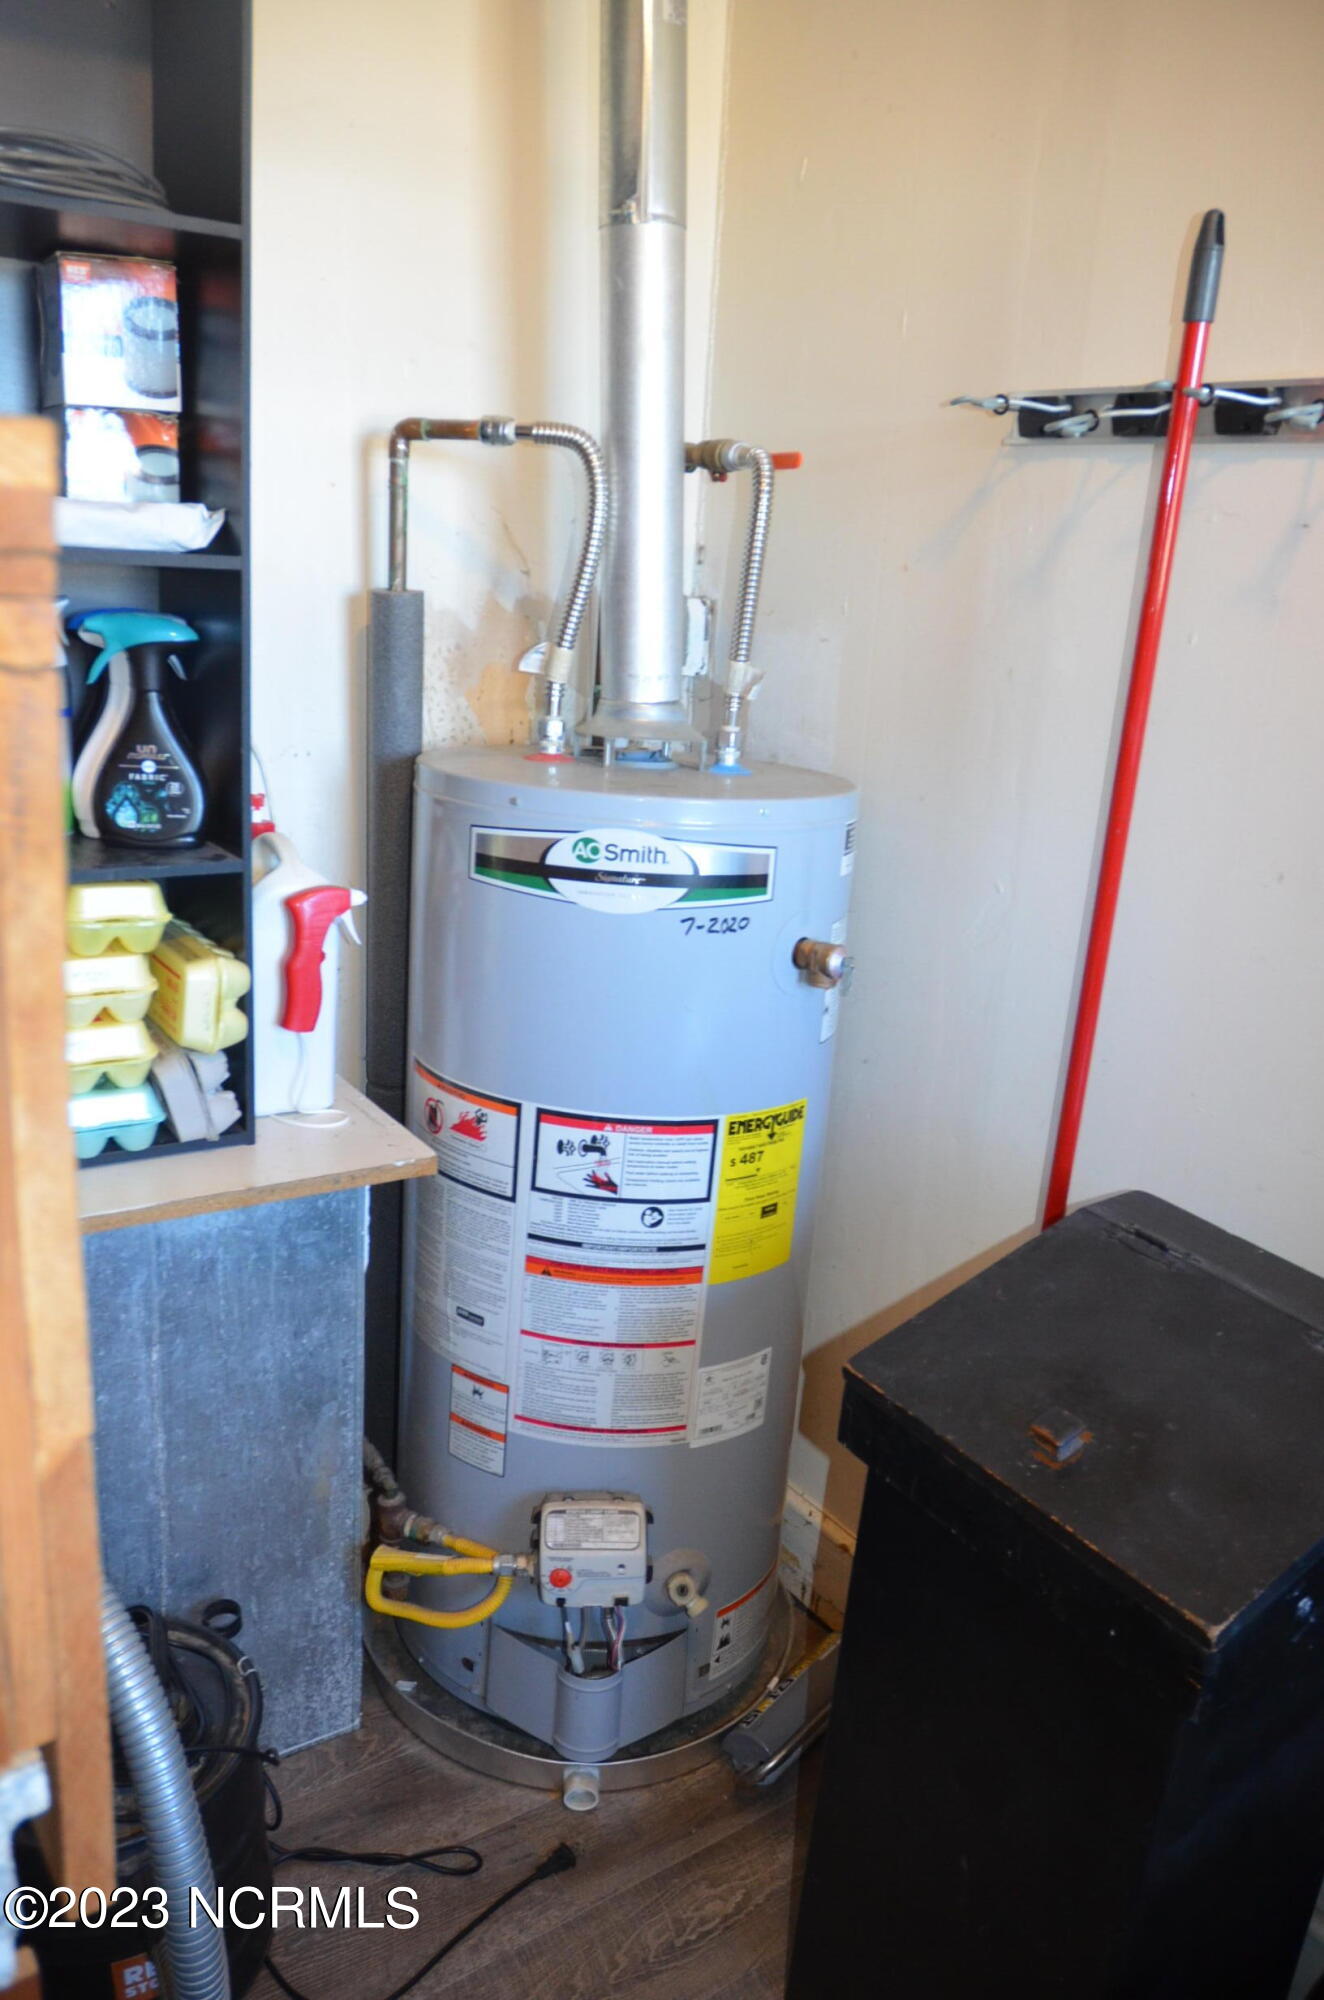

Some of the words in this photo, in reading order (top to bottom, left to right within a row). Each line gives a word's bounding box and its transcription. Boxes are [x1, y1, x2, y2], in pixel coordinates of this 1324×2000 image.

[128, 773, 167, 781] FABRIC
[604, 843, 668, 864] Smith
[680, 915, 751, 936] 7-2020
[615, 1124, 654, 1134] DANGER
[739, 1150, 765, 1166] 487
